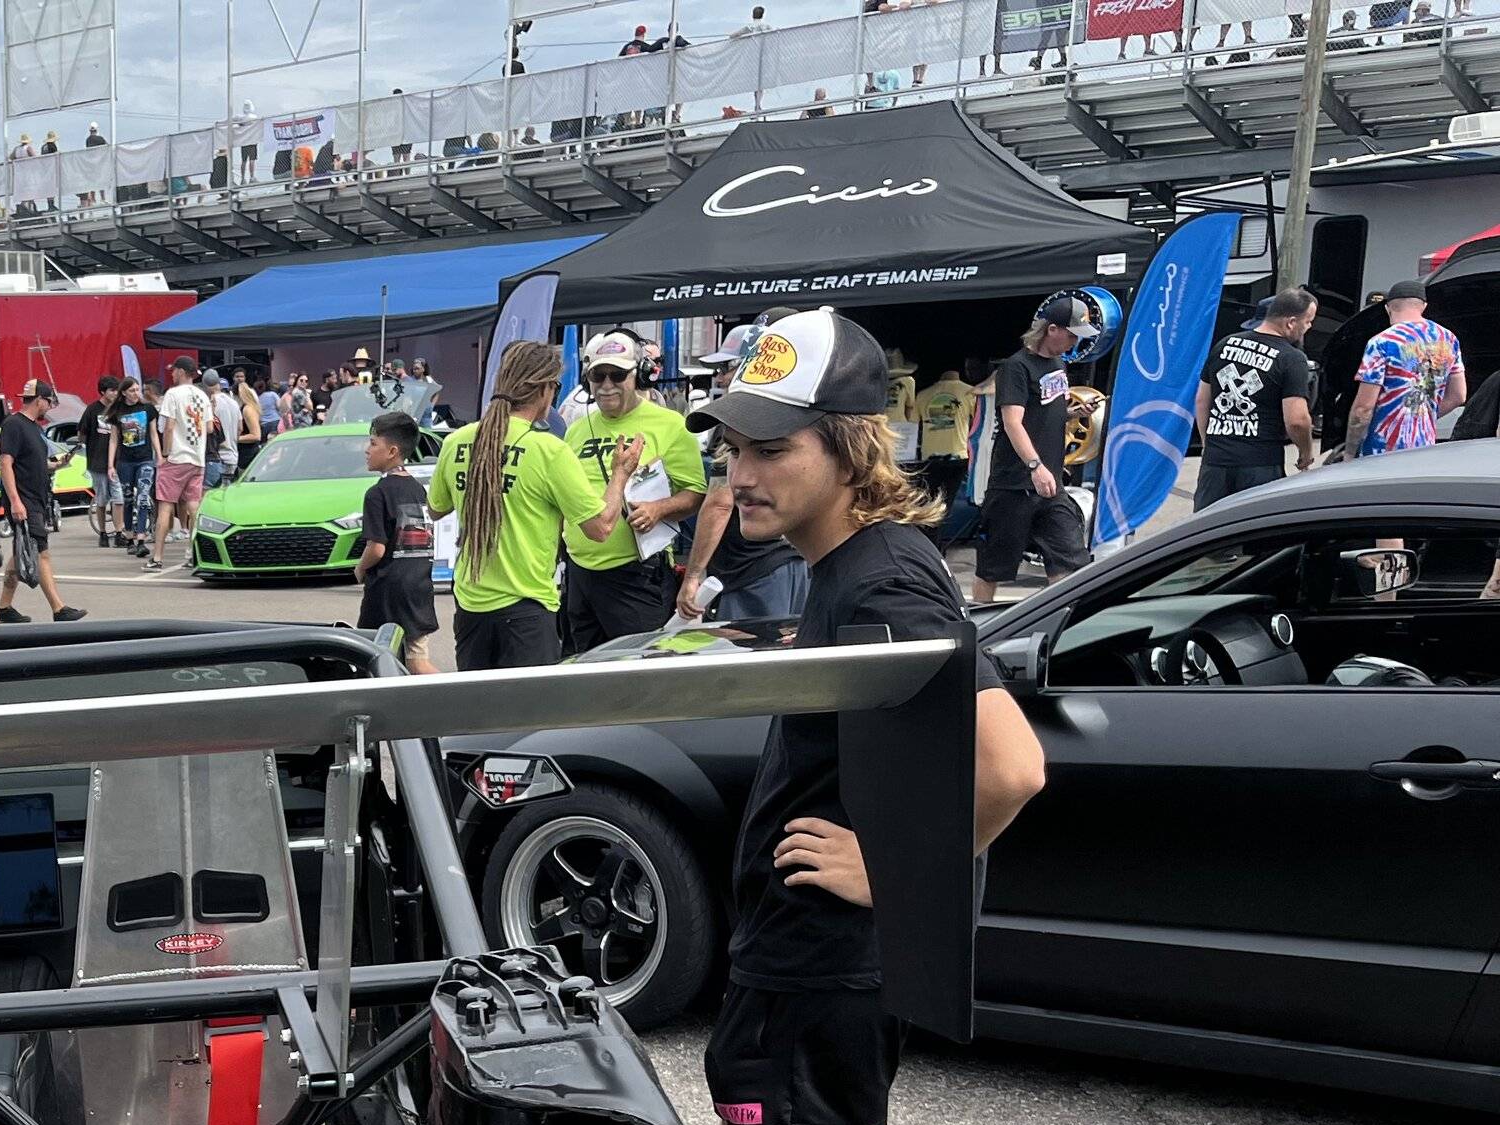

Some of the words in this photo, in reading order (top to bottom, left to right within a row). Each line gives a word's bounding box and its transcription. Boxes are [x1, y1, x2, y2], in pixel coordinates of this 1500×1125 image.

[702, 165, 938, 217] Cicio
[653, 282, 703, 303] CARS
[714, 278, 802, 297] CULTURE
[810, 265, 979, 292] CRAFTSMANSHIP
[1131, 263, 1178, 381] Cicio
[760, 336, 790, 354] Bass
[755, 349, 777, 364] Pro
[1220, 345, 1274, 372] STROKED
[748, 361, 786, 381] Shops
[1206, 416, 1259, 437] BLOWN
[164, 938, 214, 948] KIRKEY
